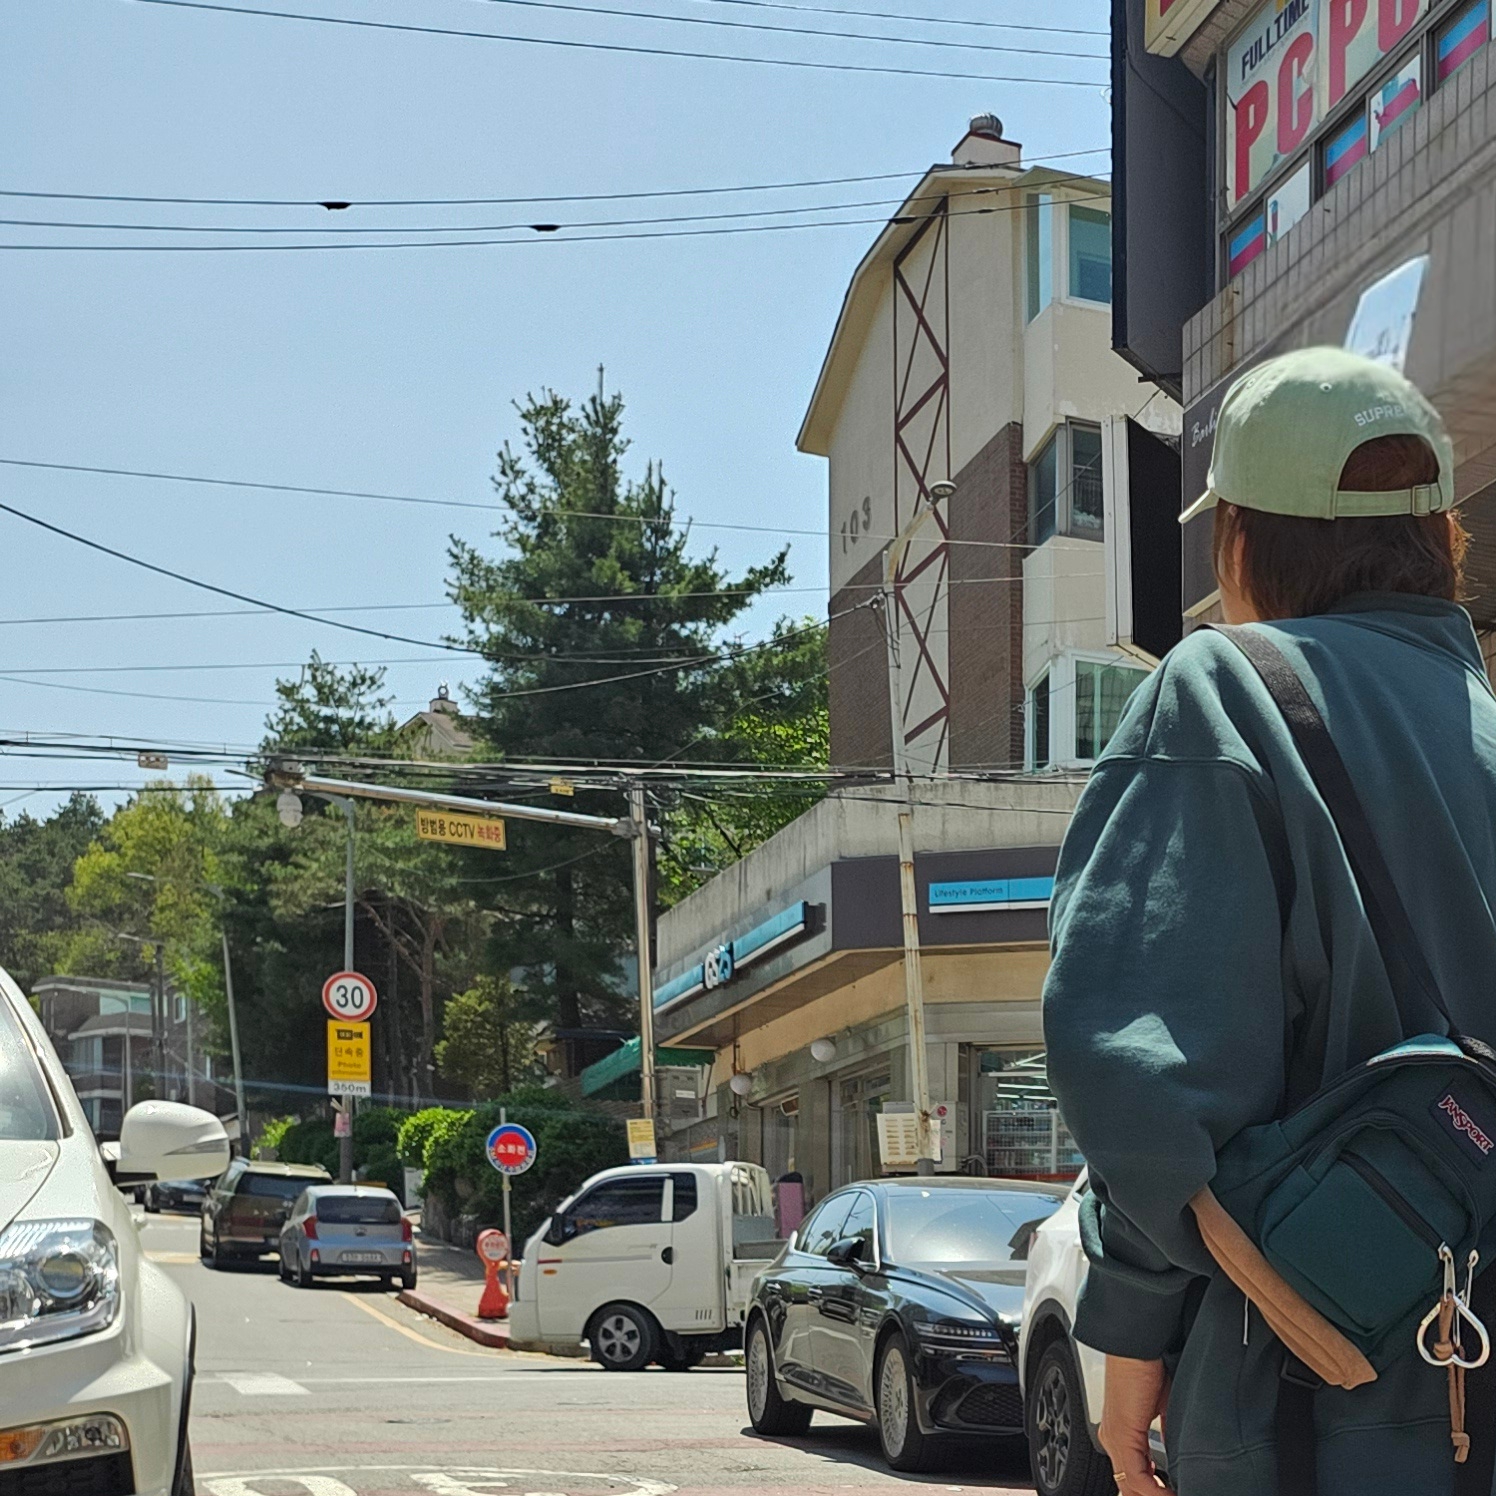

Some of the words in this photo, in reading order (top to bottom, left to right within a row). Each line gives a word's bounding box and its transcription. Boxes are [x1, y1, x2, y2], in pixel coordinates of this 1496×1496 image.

[1354, 405, 1405, 426] SUPRE
[421, 816, 446, 836] 방범용
[449, 821, 475, 839] CCTV
[477, 823, 501, 843] 녹화중
[934, 888, 967, 899] Lifestyle
[970, 887, 1003, 896] Platform
[336, 985, 363, 1009] 30
[333, 1083, 366, 1093] 350m
[1438, 1094, 1495, 1155] JANSPORT
